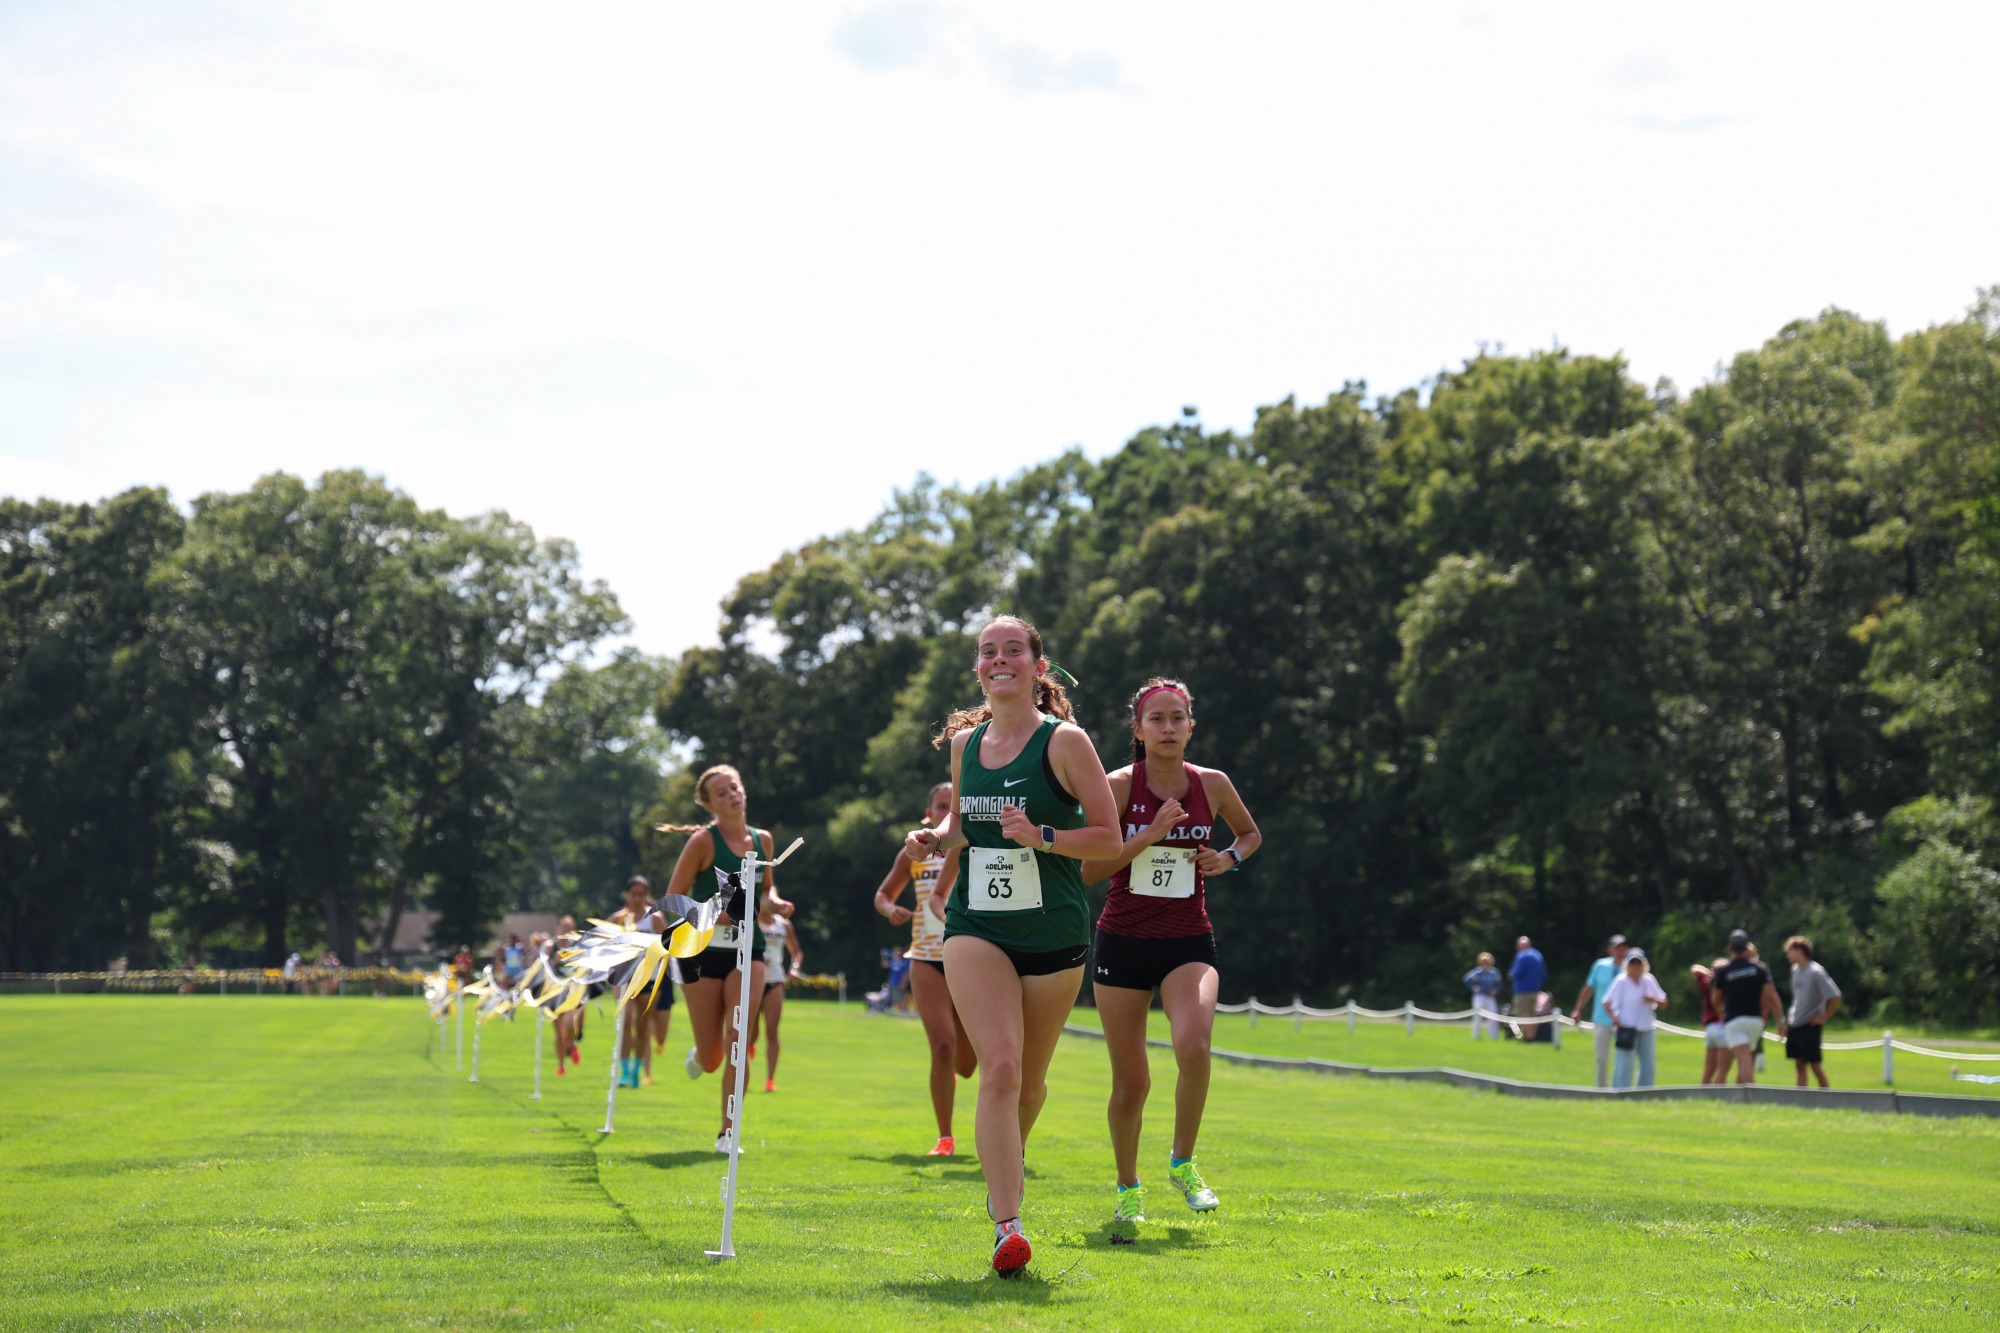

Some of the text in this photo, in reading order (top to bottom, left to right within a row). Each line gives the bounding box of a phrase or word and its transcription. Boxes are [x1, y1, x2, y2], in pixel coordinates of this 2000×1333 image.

[1125, 823, 1212, 840] MLLOY
[985, 863, 1014, 871] ADELPHI
[1152, 869, 1173, 887] 87
[988, 877, 1013, 899] 63
